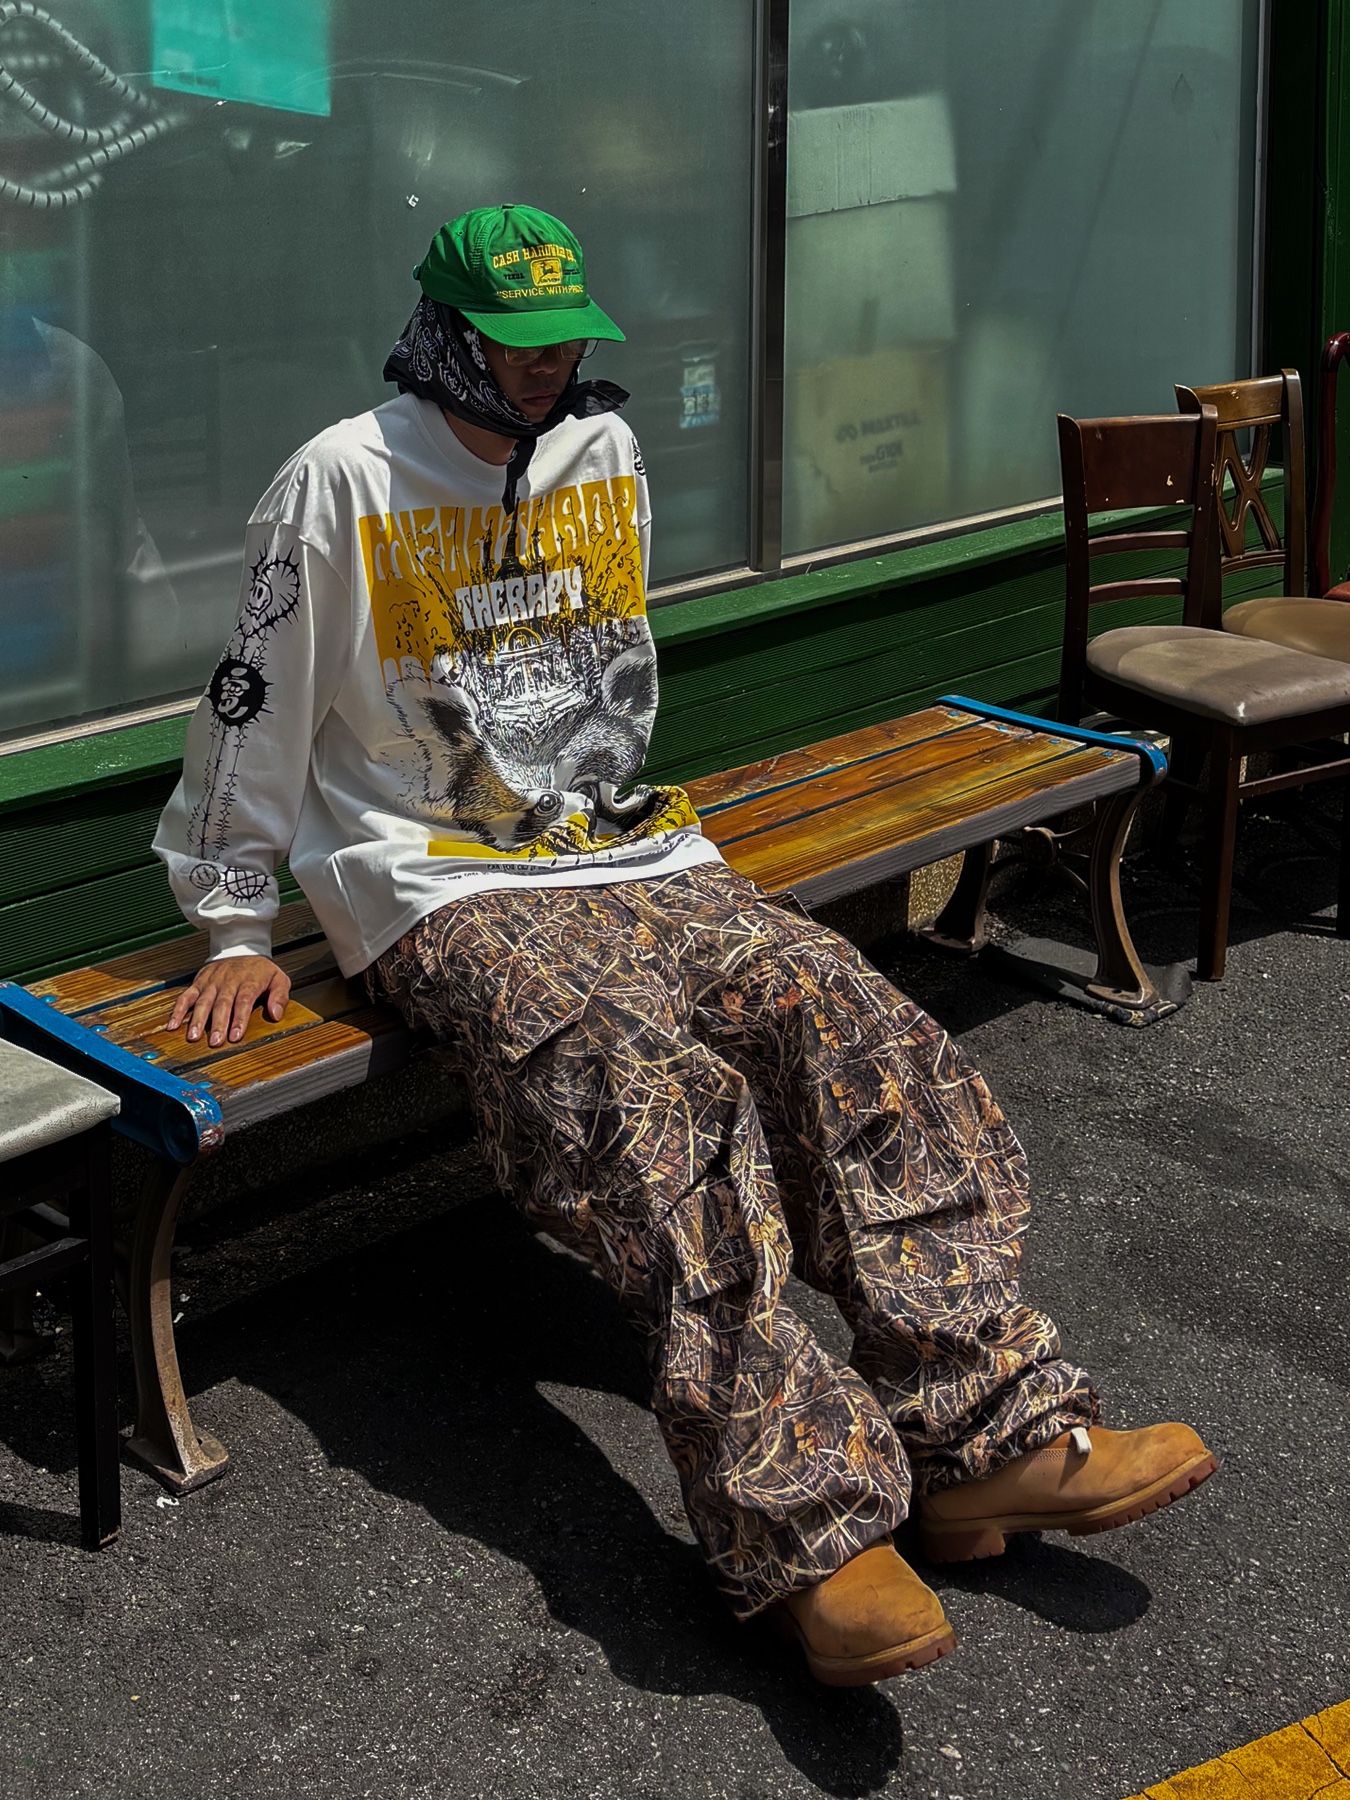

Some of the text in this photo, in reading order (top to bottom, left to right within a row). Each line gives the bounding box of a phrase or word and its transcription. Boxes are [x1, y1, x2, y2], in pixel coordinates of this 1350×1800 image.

[493, 250, 520, 269] CASH
[546, 285, 567, 295] WITH
[454, 566, 583, 632] THERAPY
